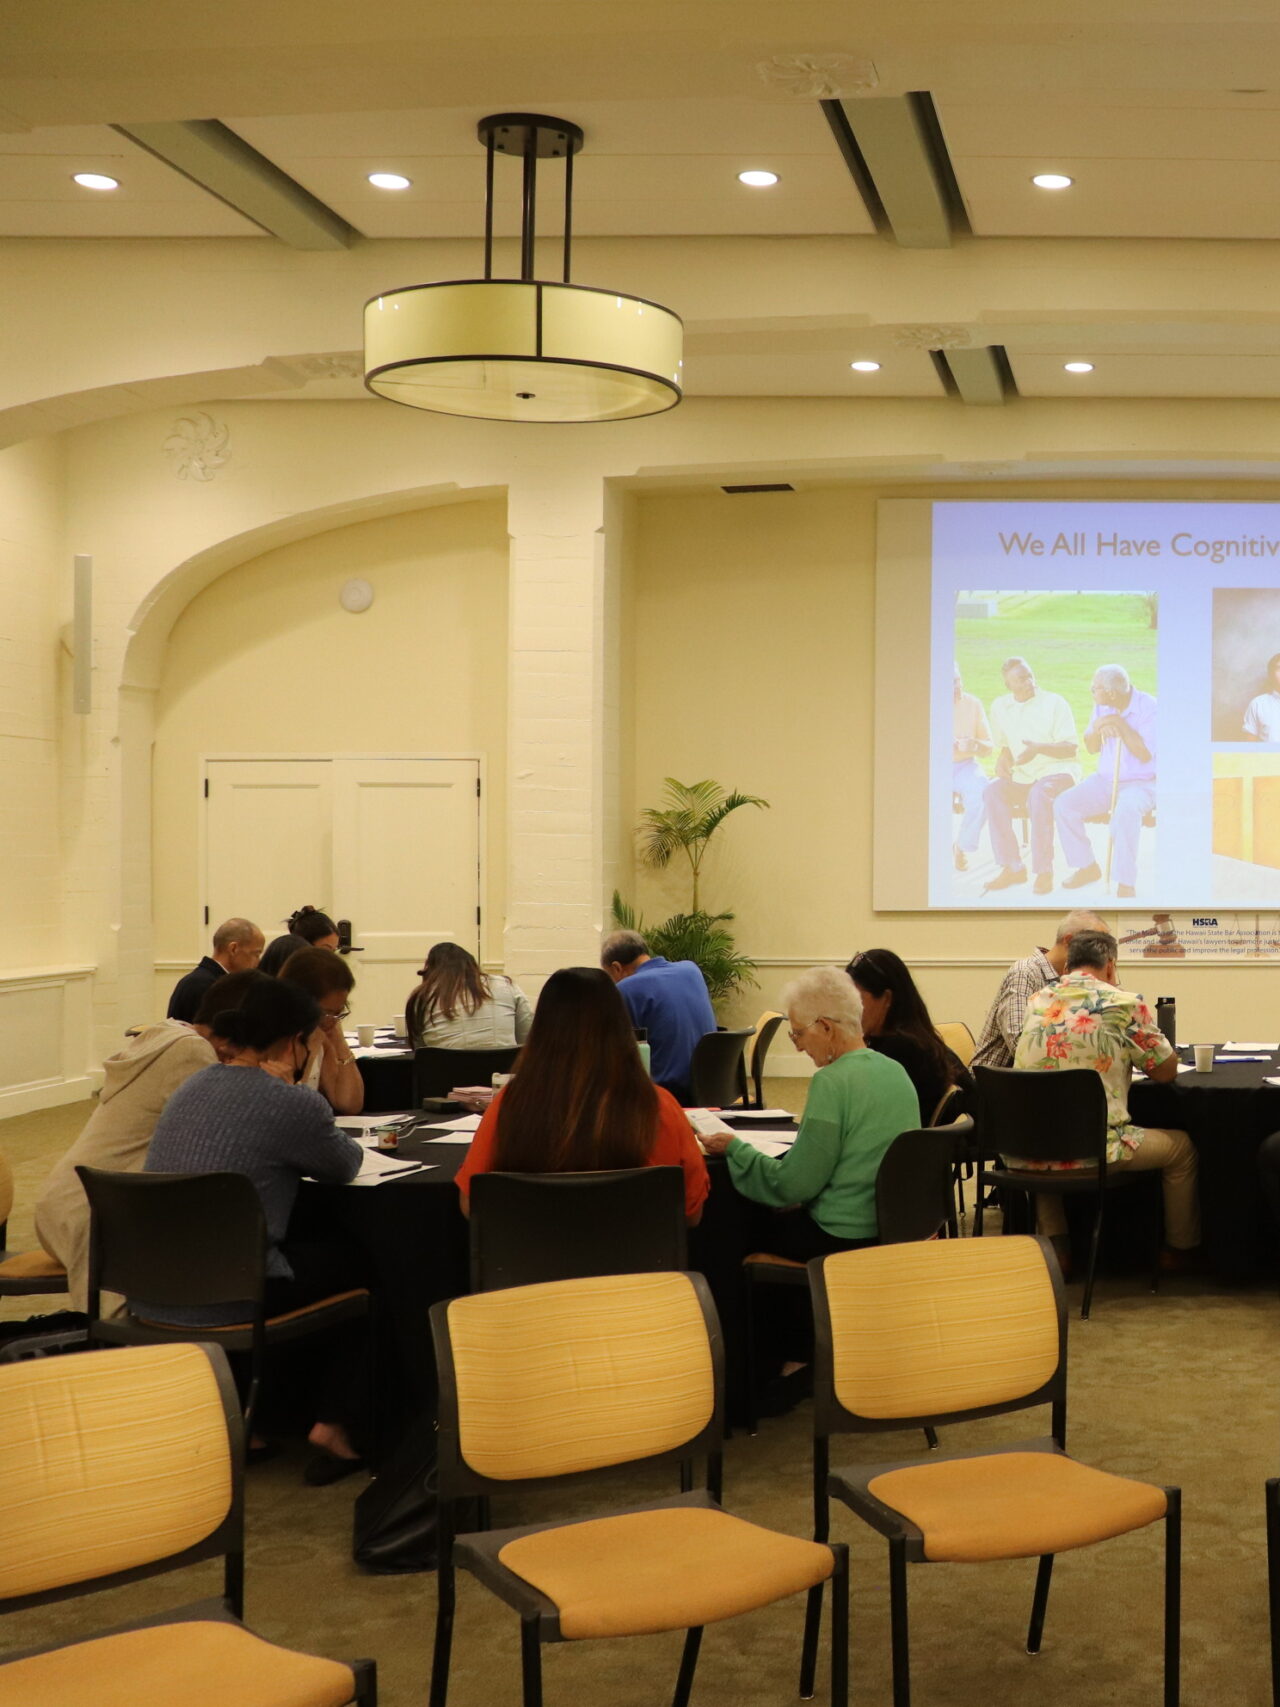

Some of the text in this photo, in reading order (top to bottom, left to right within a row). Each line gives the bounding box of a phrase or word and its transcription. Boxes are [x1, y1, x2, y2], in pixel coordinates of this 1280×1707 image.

[999, 532, 1044, 557] We
[1051, 532, 1086, 557] All
[1097, 533, 1161, 557] Have
[1230, 947, 1245, 956] legal
